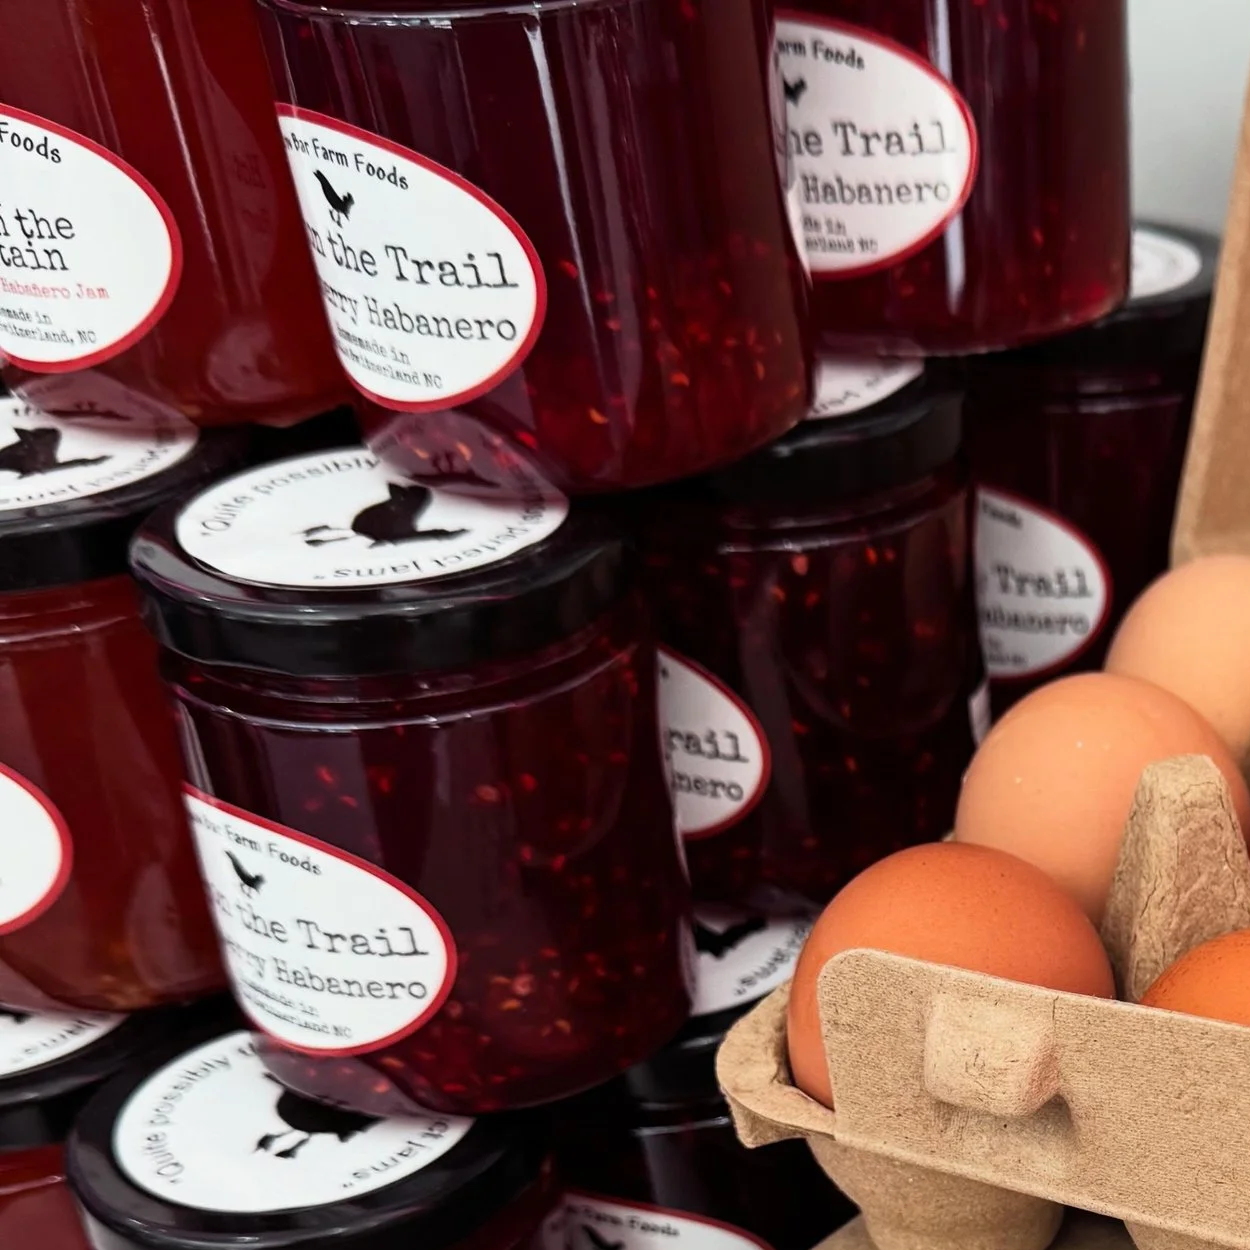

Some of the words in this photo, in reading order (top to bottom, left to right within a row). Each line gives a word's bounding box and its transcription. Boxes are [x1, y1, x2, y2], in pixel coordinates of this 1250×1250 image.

[832, 121, 956, 158] Trail
[311, 137, 350, 168] Farm
[353, 152, 409, 191] Foods
[801, 174, 951, 206] Habanero
[14, 207, 76, 240] the
[328, 229, 378, 277] the
[384, 244, 520, 289] Trail
[362, 295, 518, 342] Habanero
[266, 841, 322, 876] Foods
[235, 900, 289, 944] the
[296, 917, 430, 957] Trail
[272, 956, 428, 1000] Habanero
[149, 1055, 232, 1127] possibly
